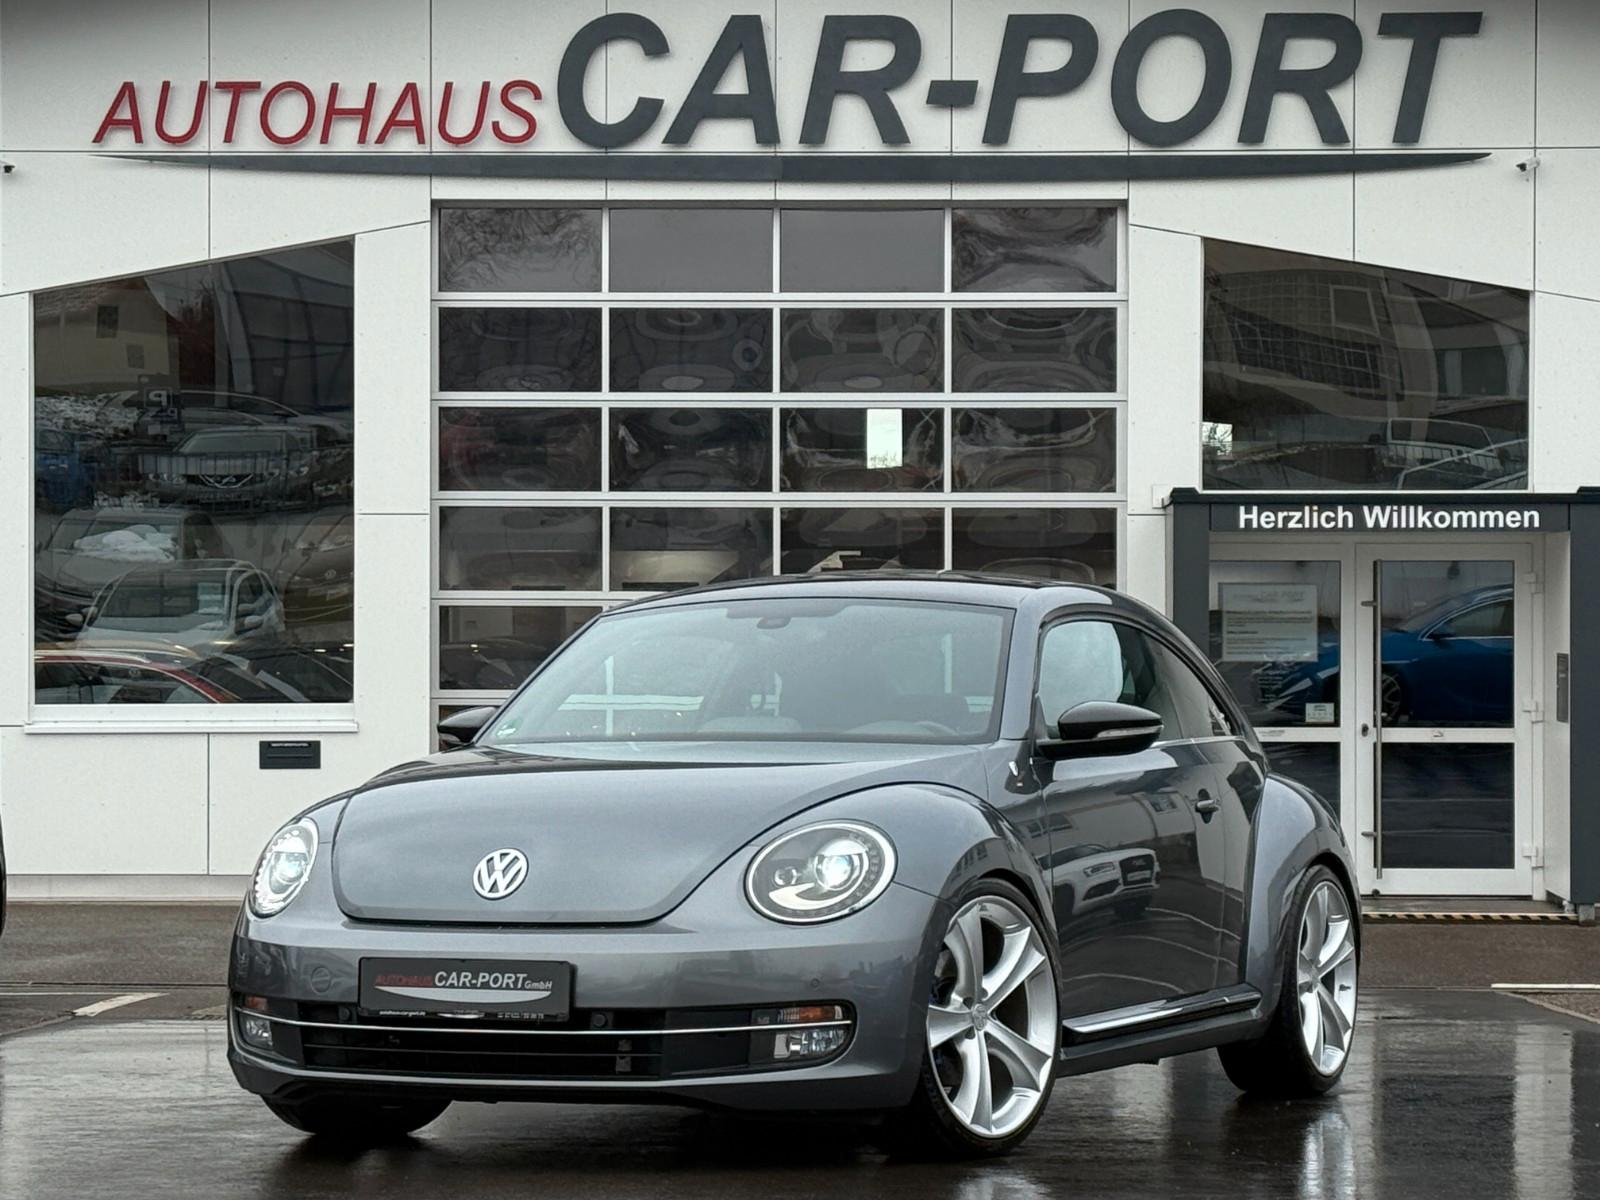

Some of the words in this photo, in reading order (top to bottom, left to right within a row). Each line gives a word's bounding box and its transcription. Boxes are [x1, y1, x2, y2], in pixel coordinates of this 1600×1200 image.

[92, 80, 542, 145] AUTOHAUS
[556, 9, 1483, 149] CAR-PORT
[1238, 505, 1353, 529] Herzlich
[1362, 505, 1540, 529] Willkommen
[434, 971, 528, 989] CAR-PORT
[524, 980, 552, 989] GmbH
